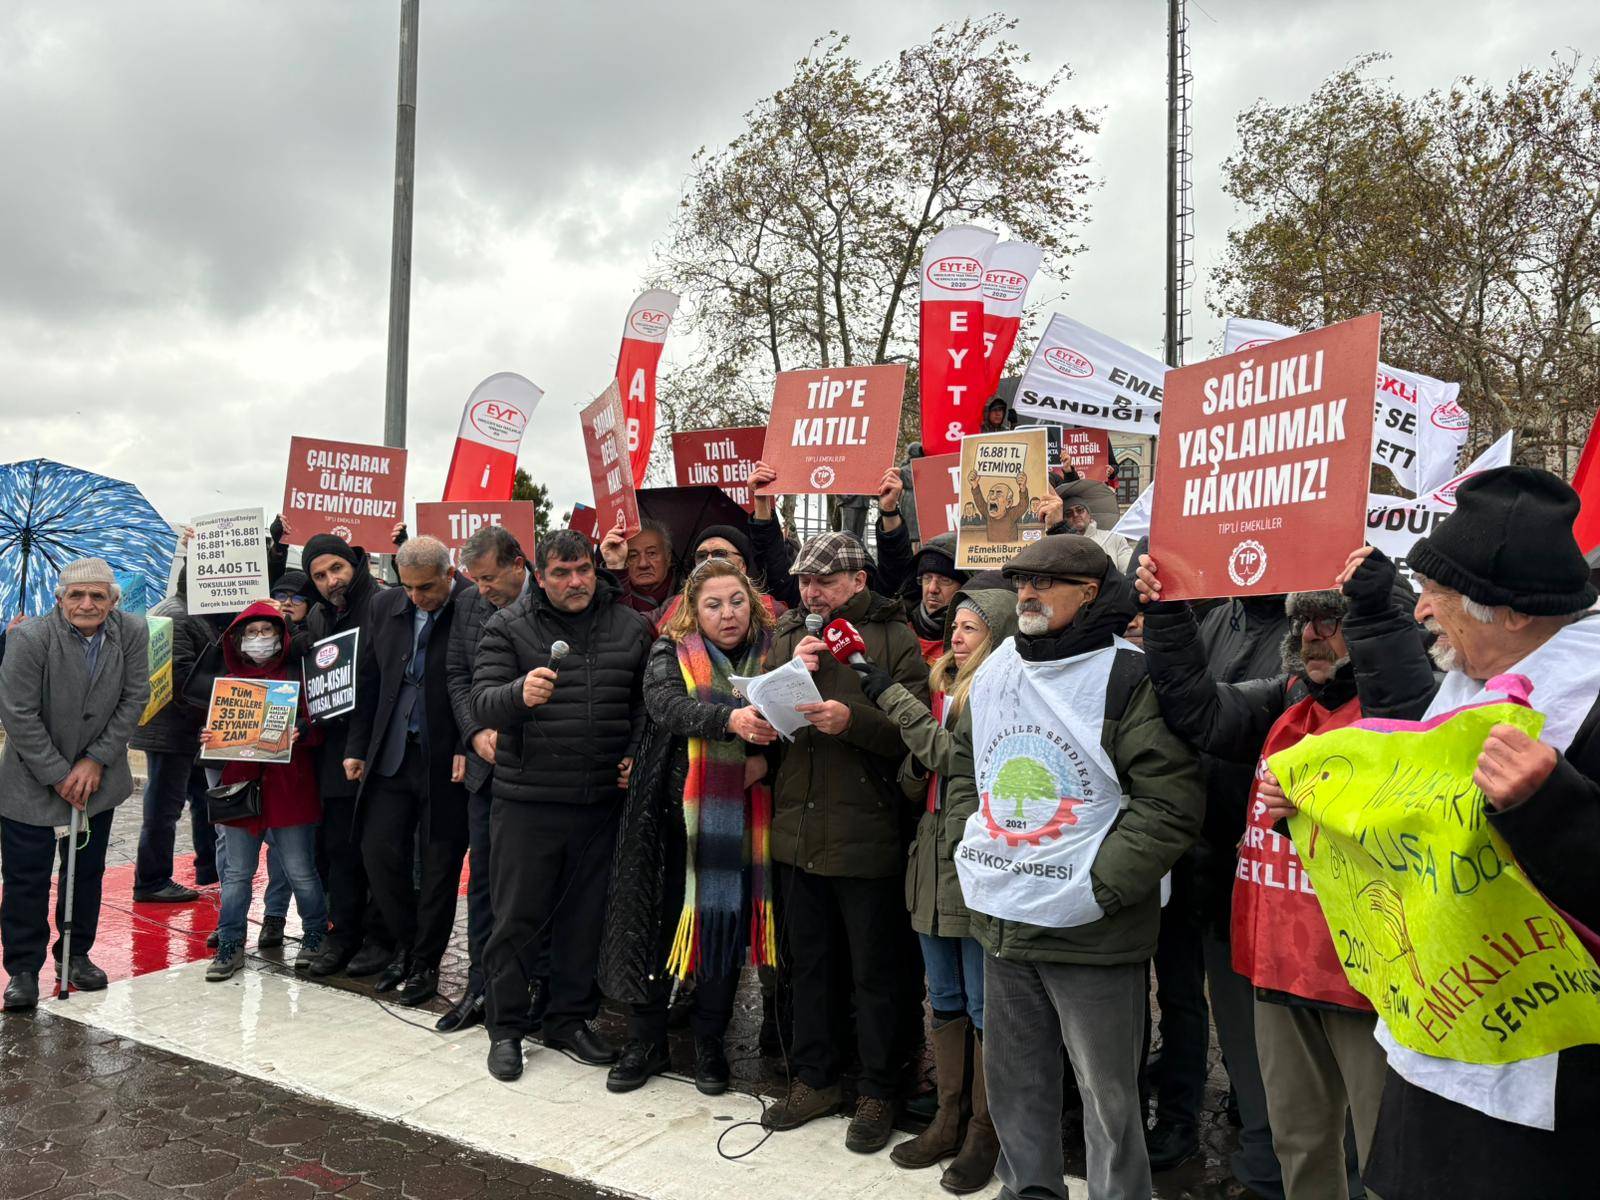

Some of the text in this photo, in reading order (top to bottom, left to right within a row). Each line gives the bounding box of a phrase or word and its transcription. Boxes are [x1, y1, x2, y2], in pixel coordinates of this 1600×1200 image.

[1202, 350, 1324, 416] SAĞLIKLI
[791, 416, 870, 447] KATIL!
[1070, 432, 1090, 443] TATİL
[1178, 398, 1348, 476] YAŞLANMAK
[704, 437, 738, 461] TATİL
[979, 446, 1020, 458] 16.881 TL
[306, 449, 391, 474] ÇALIŞARAK
[977, 460, 1022, 474] YETMİYOR
[687, 462, 719, 485] LÜKS
[320, 469, 374, 494] ÖLMEK
[1182, 457, 1329, 517] HAKKIMIZ!
[290, 488, 397, 518] İSTEMİYORUZ!
[197, 551, 225, 560] 16.881
[1239, 550, 1258, 565] TİP
[197, 561, 260, 576] 84.405 TL
[198, 580, 237, 589] YOKSULLUK
[210, 588, 238, 597] 97.159
[231, 686, 252, 699] TÜM
[219, 707, 235, 719] 35
[211, 720, 260, 731] SEYYANEN
[222, 730, 247, 742] ZAM
[1005, 819, 1027, 829] 2021
[960, 846, 1073, 880] BEYKOZ ŞUBESİ
